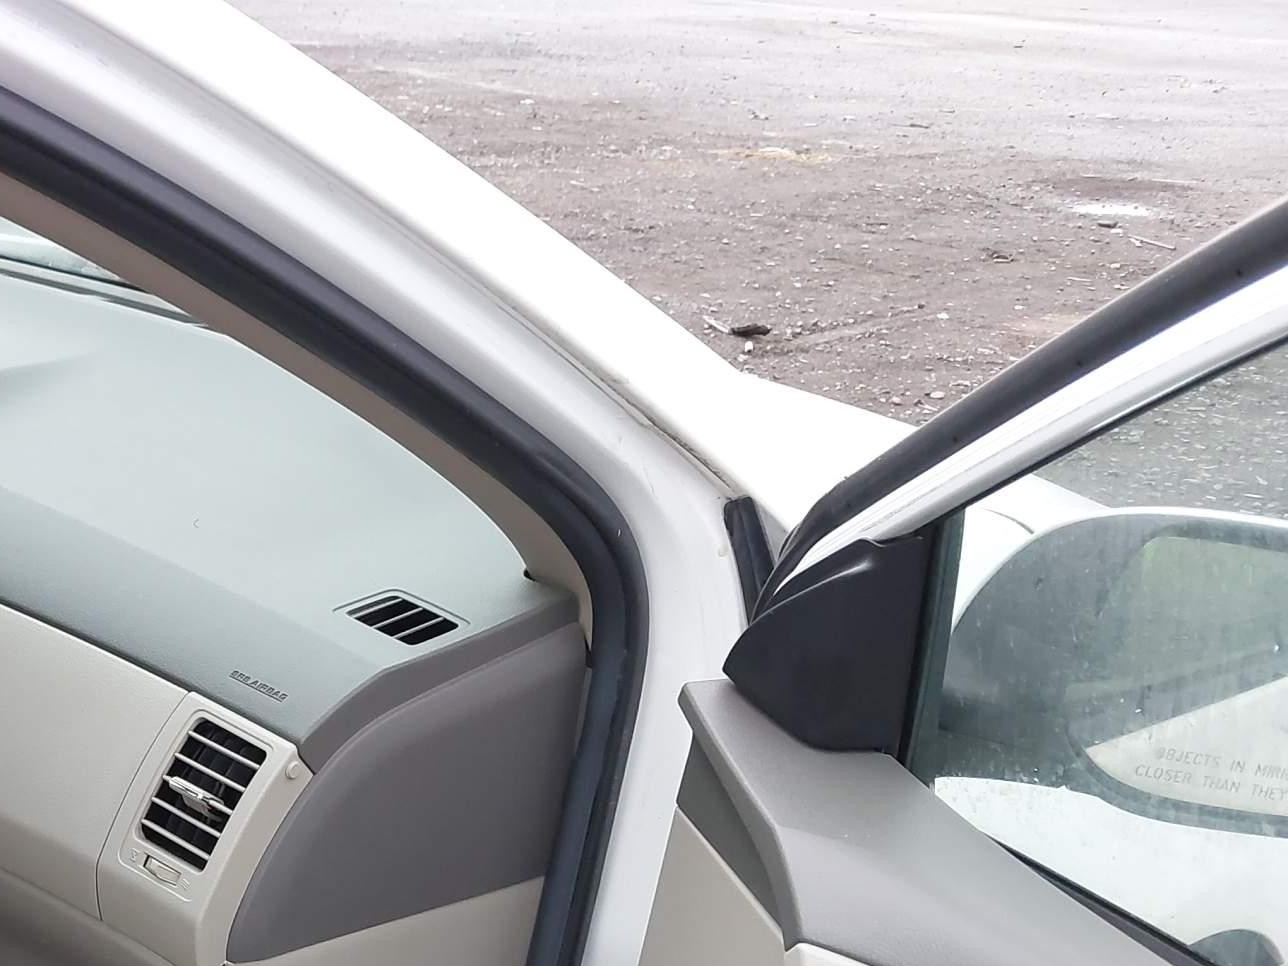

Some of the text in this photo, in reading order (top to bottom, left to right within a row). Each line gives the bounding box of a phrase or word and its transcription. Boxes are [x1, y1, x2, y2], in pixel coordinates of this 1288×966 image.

[250, 680, 289, 701] AIRBAG
[1158, 746, 1221, 768] OBJECTS
[1230, 759, 1247, 773] IN
[1135, 764, 1192, 784] CLOSER
[1203, 775, 1241, 793] THAN
